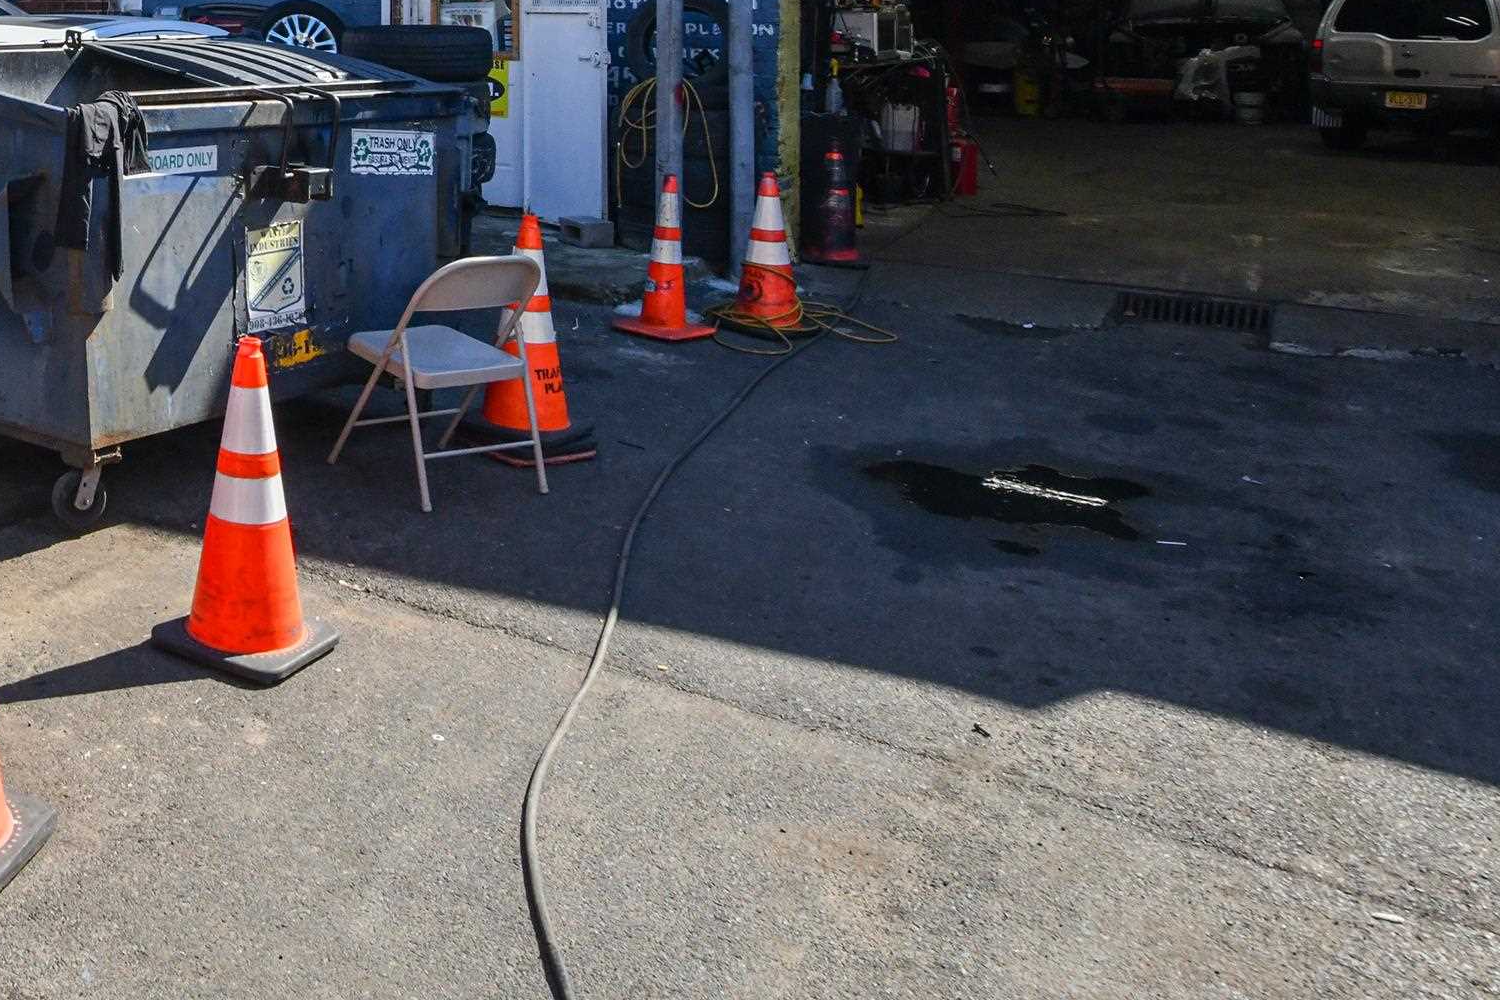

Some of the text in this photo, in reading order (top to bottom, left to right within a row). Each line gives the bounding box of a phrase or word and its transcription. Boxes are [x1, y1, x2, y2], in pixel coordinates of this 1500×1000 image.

[369, 136, 418, 151] TRASH ONLY
[187, 151, 213, 167] ONLY
